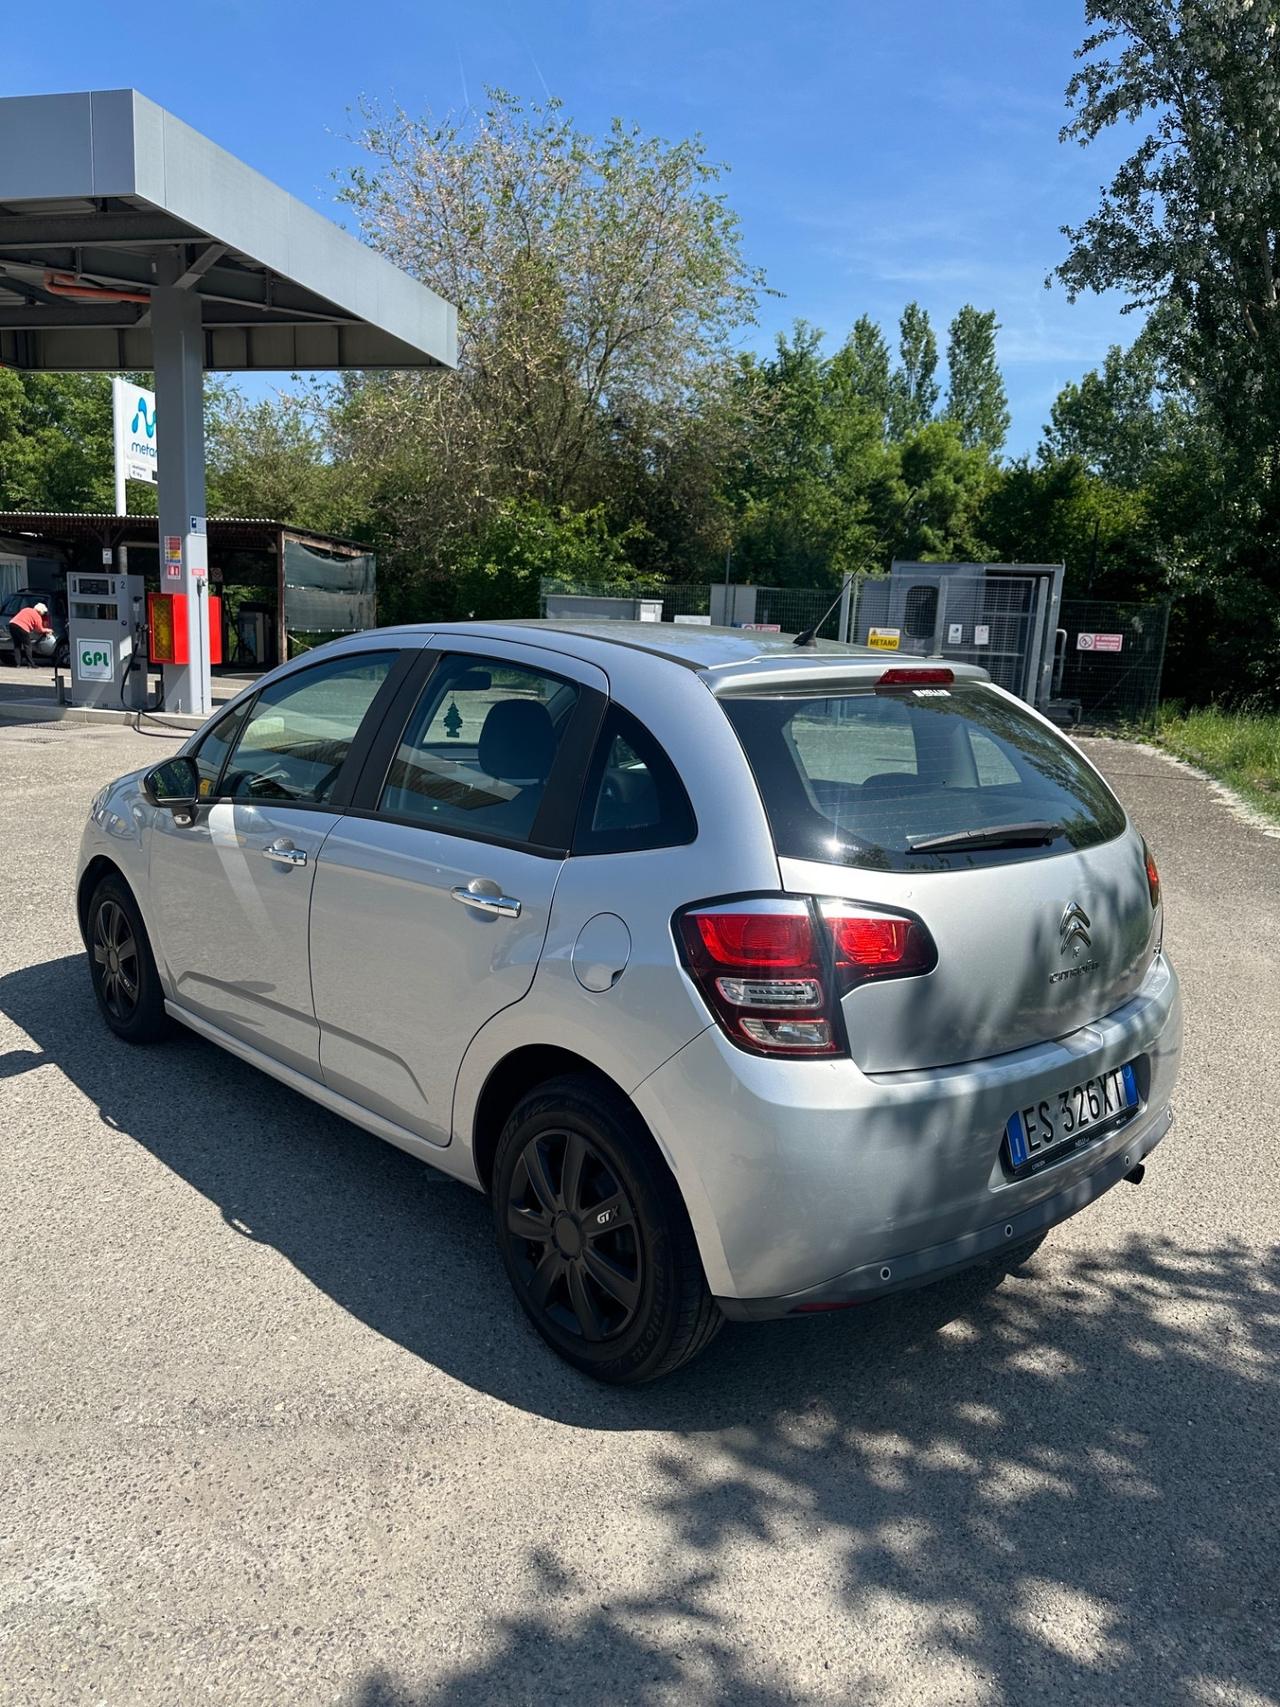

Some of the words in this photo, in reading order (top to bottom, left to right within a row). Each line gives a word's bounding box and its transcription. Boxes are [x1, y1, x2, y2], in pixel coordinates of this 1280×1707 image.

[131, 441, 157, 457] meta
[120, 580, 126, 589] 2
[870, 638, 898, 647] METANO
[81, 650, 109, 667] GPL
[1022, 1101, 1054, 1153] ES
[1058, 1067, 1123, 1132] 326XT
